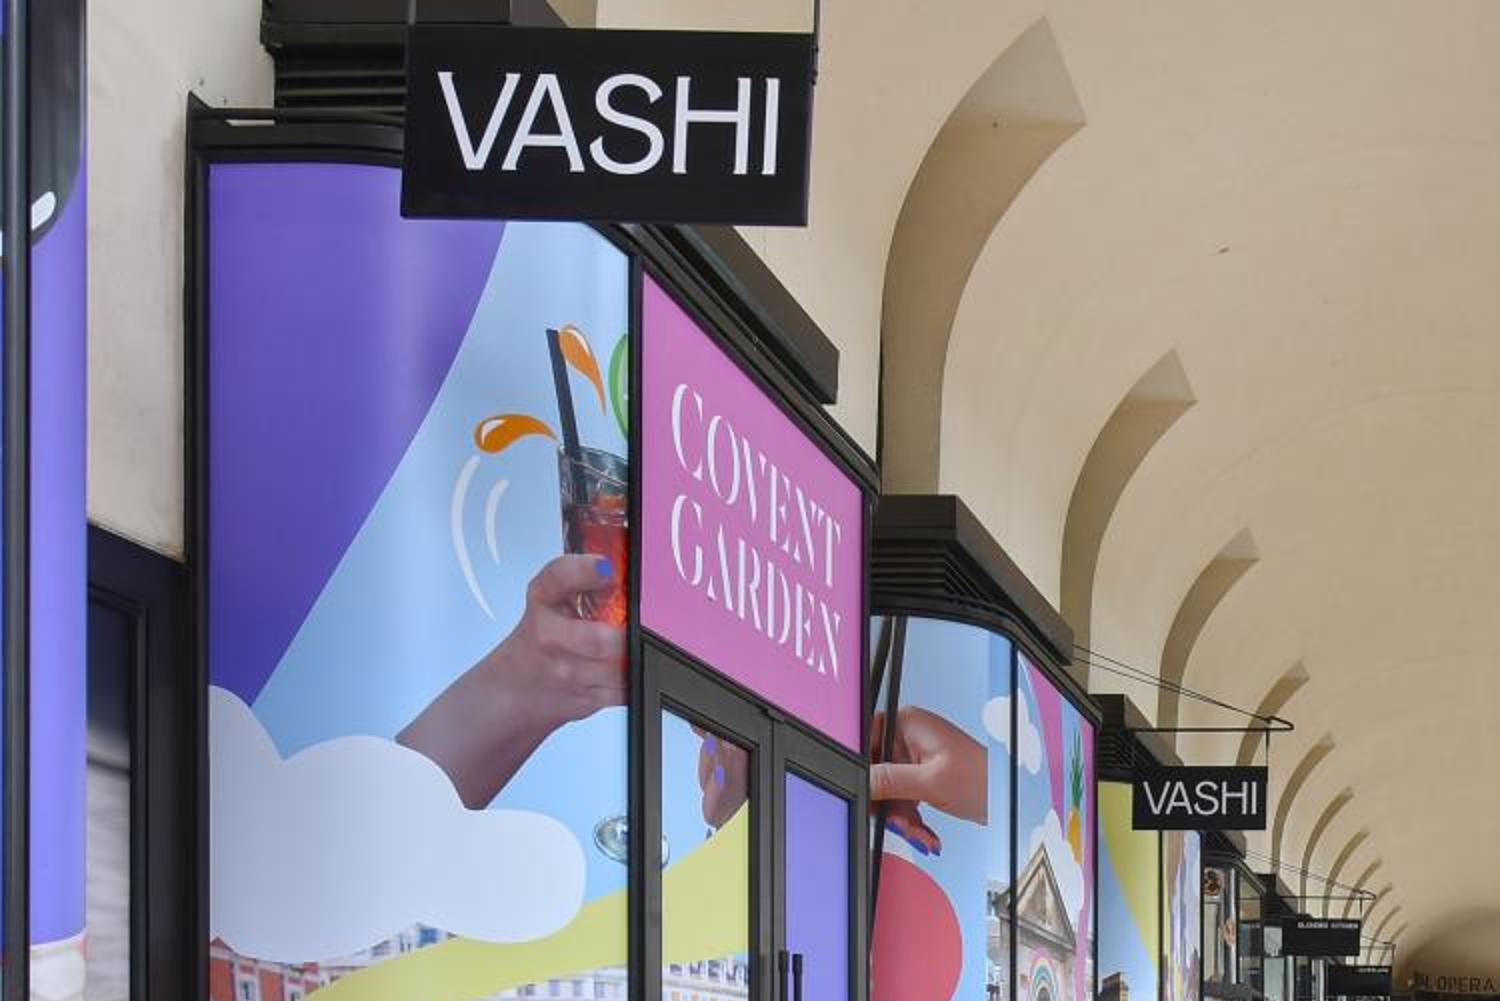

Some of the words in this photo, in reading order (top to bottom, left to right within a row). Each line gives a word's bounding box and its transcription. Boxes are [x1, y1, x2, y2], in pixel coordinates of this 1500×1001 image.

[437, 71, 780, 175] VASHI
[671, 383, 841, 588] COVENT
[671, 495, 840, 683] GARDEN
[1143, 781, 1257, 815] VASHI
[1437, 975, 1495, 993] OPERA
